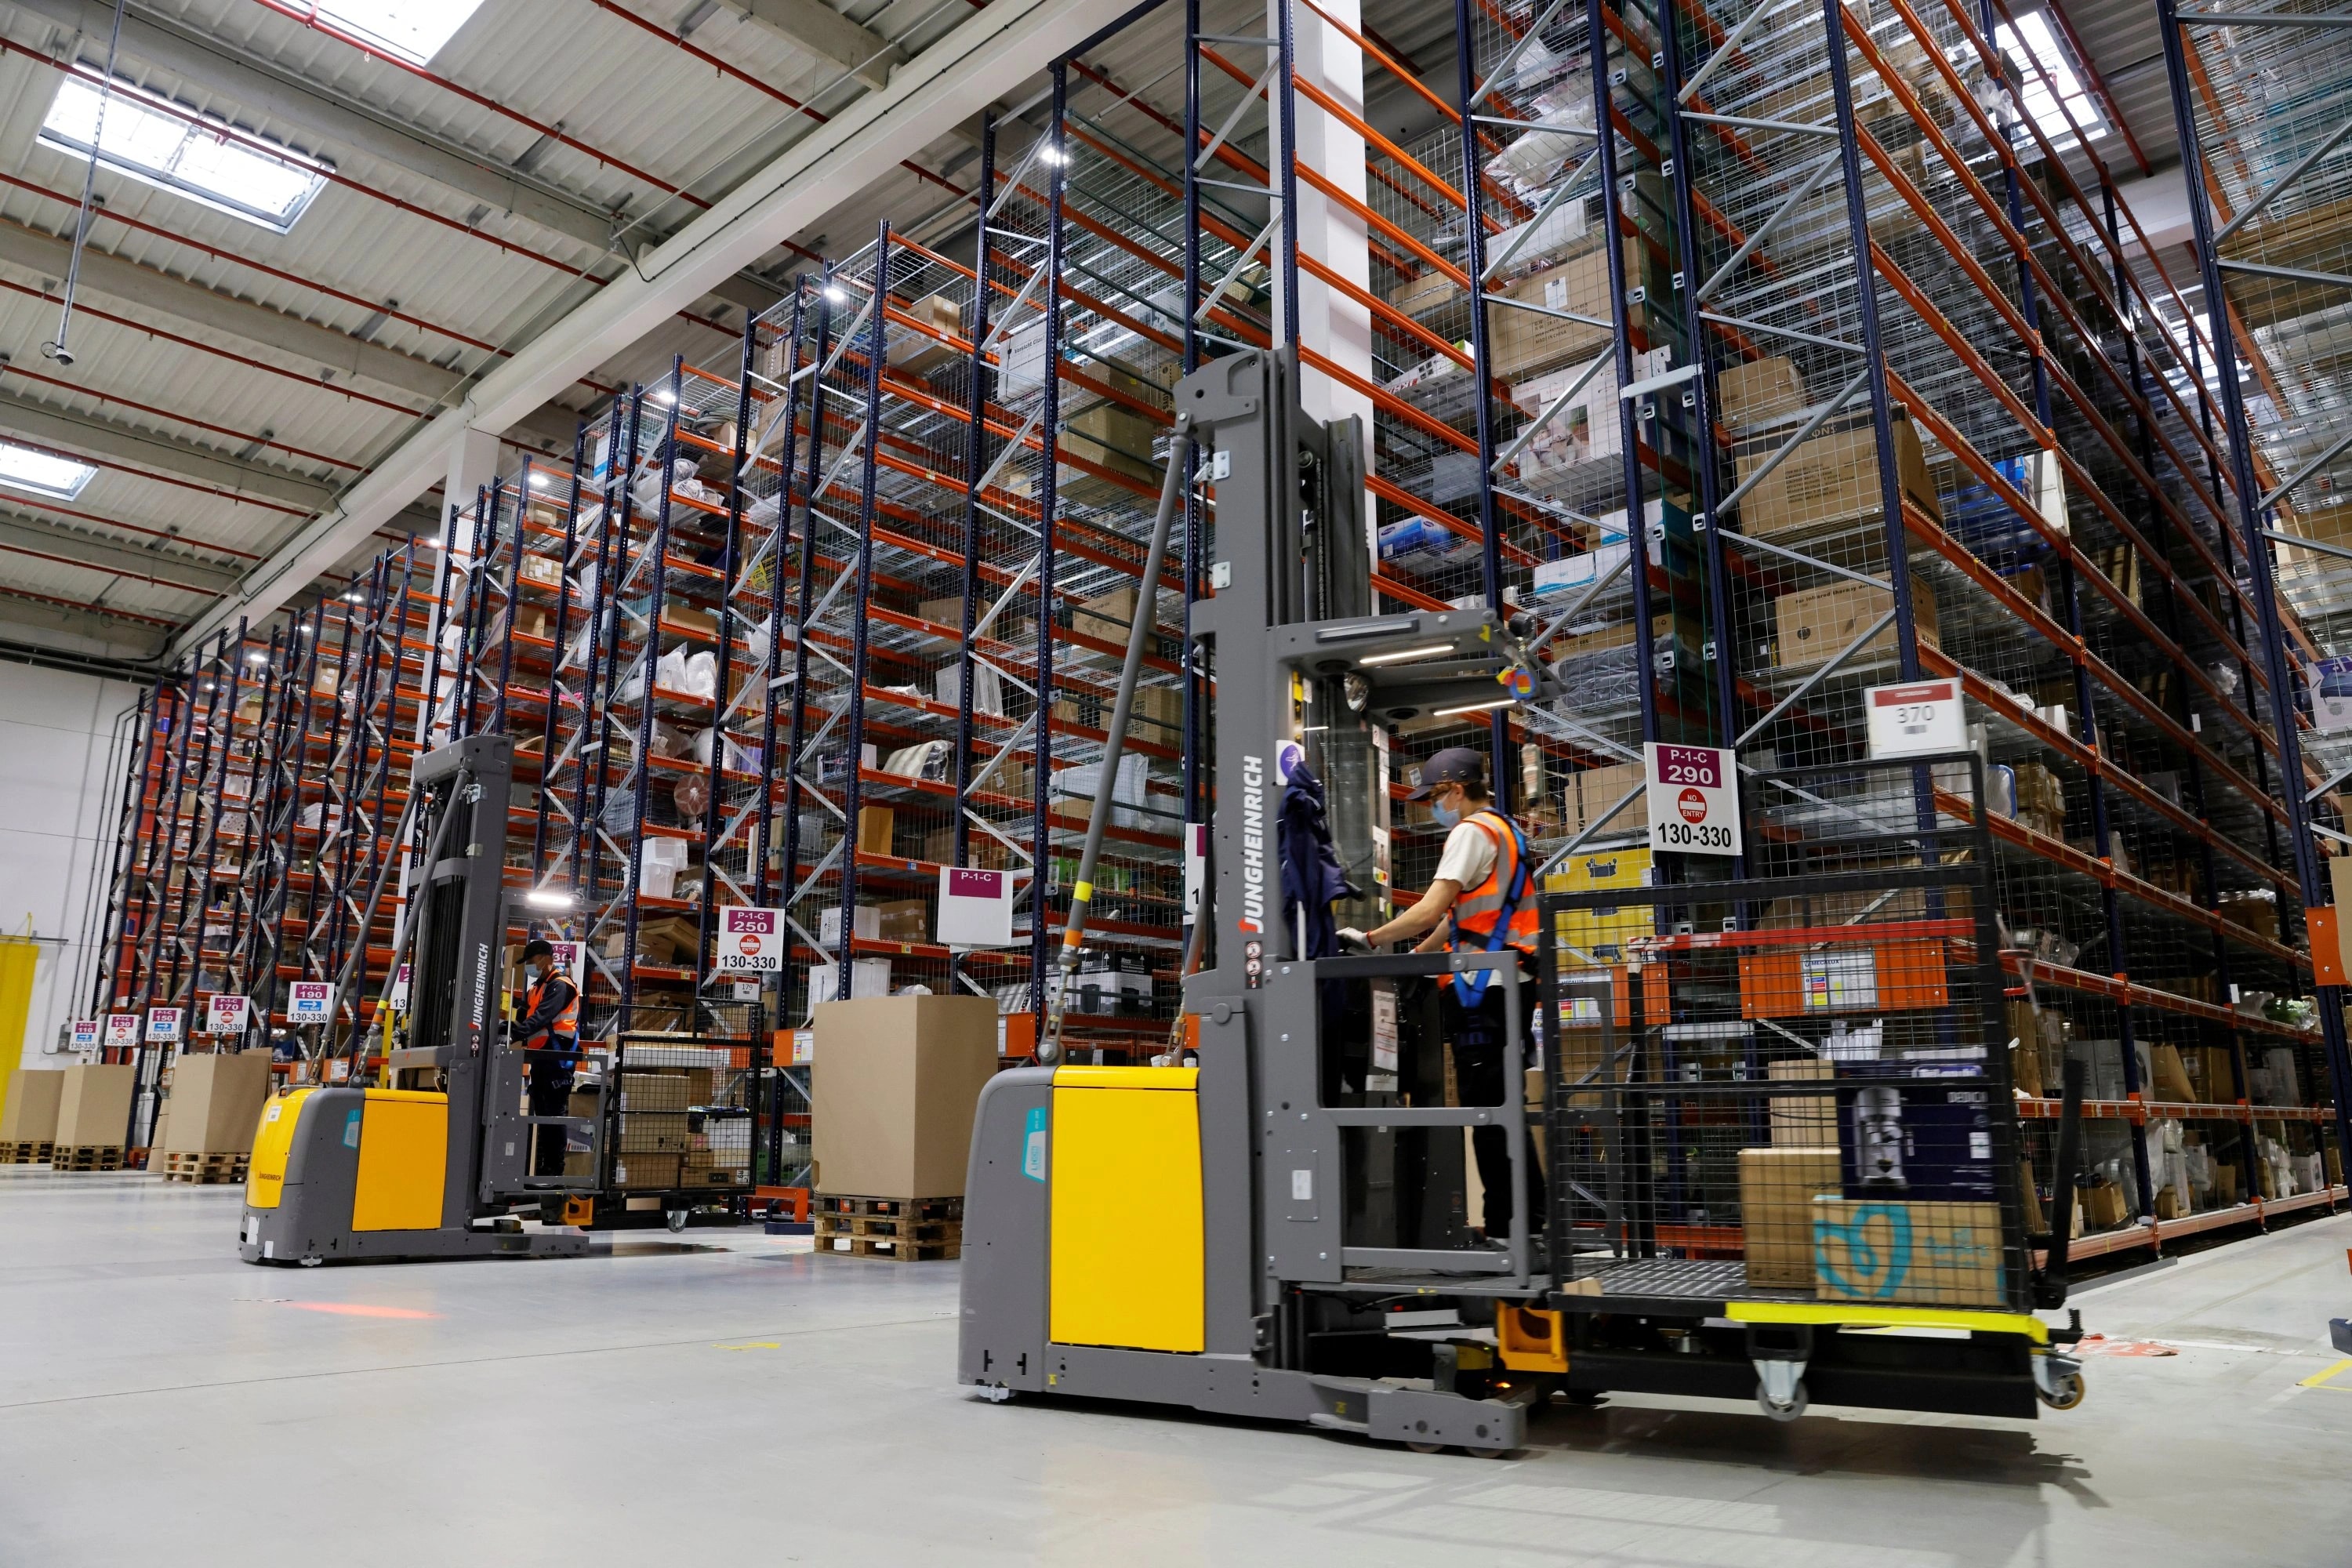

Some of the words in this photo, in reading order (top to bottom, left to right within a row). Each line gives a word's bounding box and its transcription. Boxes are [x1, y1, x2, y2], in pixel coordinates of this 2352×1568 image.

[1896, 706, 1936, 724] 370
[1670, 750, 1708, 764] P-1-C
[1668, 764, 1713, 785] 290
[1682, 810, 1704, 818] ENTRY
[1658, 822, 1731, 848] 130-330
[1238, 756, 1264, 934] JUNGHEINRICH
[961, 872, 992, 882] P-1-C
[733, 920, 768, 932] 250
[722, 955, 776, 969] 130-330
[468, 943, 489, 1031] JUNGHEINRICH
[290, 1013, 328, 1022] 130-330
